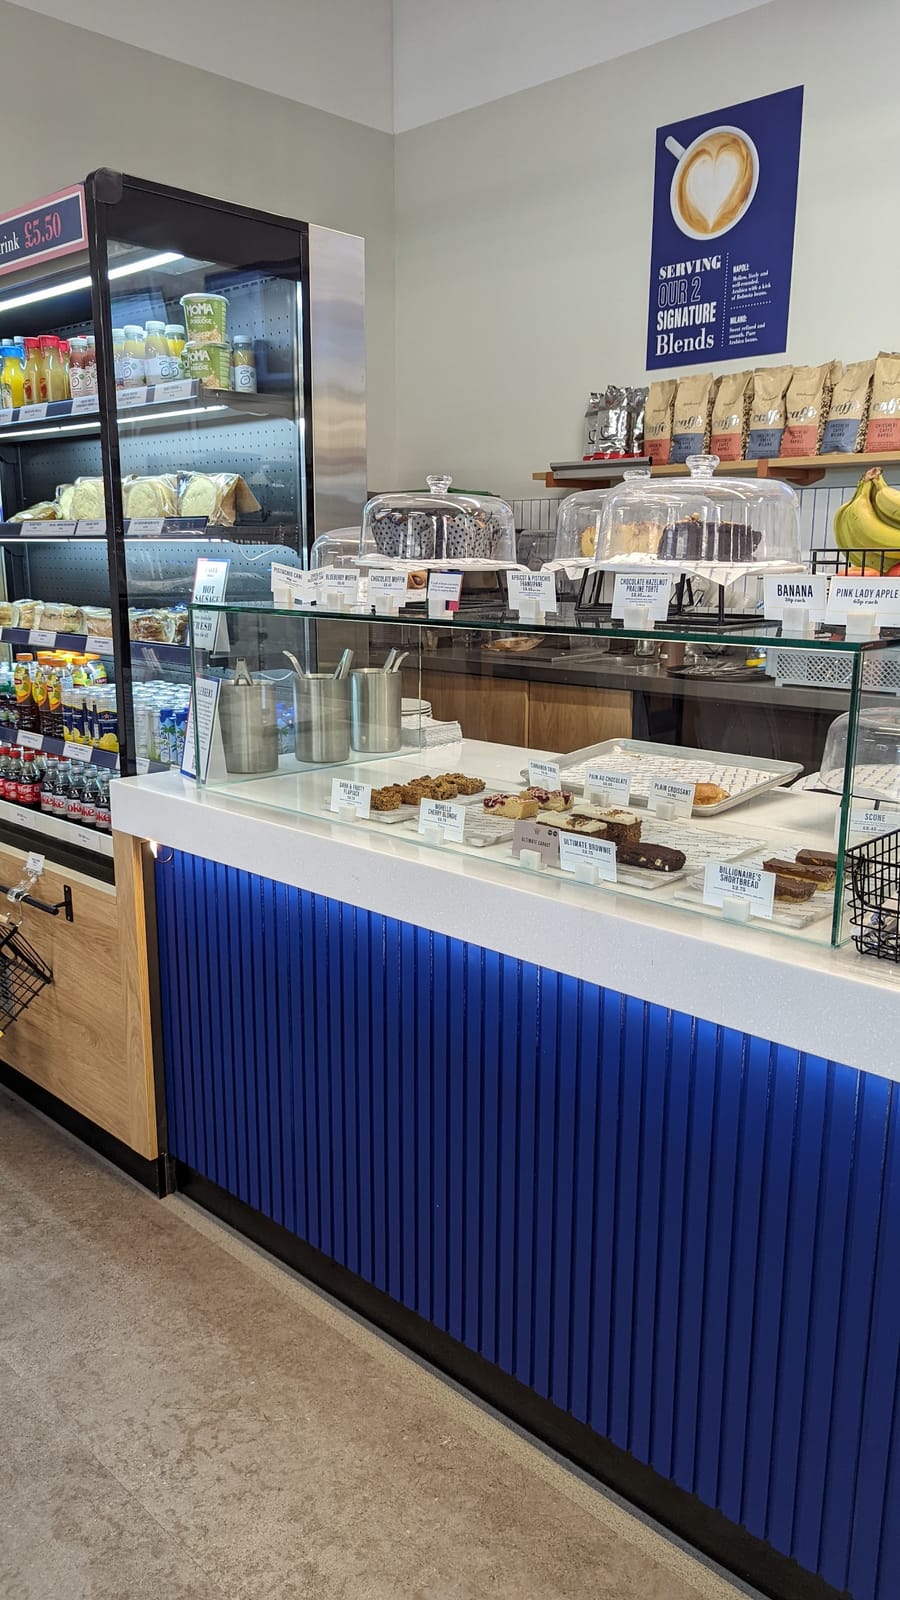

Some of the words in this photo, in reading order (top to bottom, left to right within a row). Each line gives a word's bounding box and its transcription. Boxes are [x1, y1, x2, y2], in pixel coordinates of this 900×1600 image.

[0, 231, 20, 255] rink
[24, 212, 62, 249] £5.50
[658, 254, 722, 280] SERVING
[657, 278, 688, 308] OUR
[690, 276, 702, 302] 2
[186, 303, 215, 316] MOMA
[656, 301, 717, 331] SIGNATURE
[655, 327, 714, 356] Blends
[202, 585, 215, 594] HOT
[626, 585, 644, 593] PRALINE
[645, 585, 659, 593] TORTE
[777, 584, 813, 598] BANANA
[836, 588, 853, 597] PINK
[854, 588, 874, 598] LADY
[875, 589, 899, 599] APPLE
[195, 593, 220, 603] SAUSAGE
[654, 783, 667, 791] PLAIN
[667, 785, 691, 796] CROISSANT
[864, 813, 886, 822] SCONE
[563, 838, 587, 849] ULTIMATE
[588, 843, 612, 855] BROWNIE
[719, 865, 762, 882] BILLIONAIRE'S
[720, 874, 759, 889] SHORTBREAD
